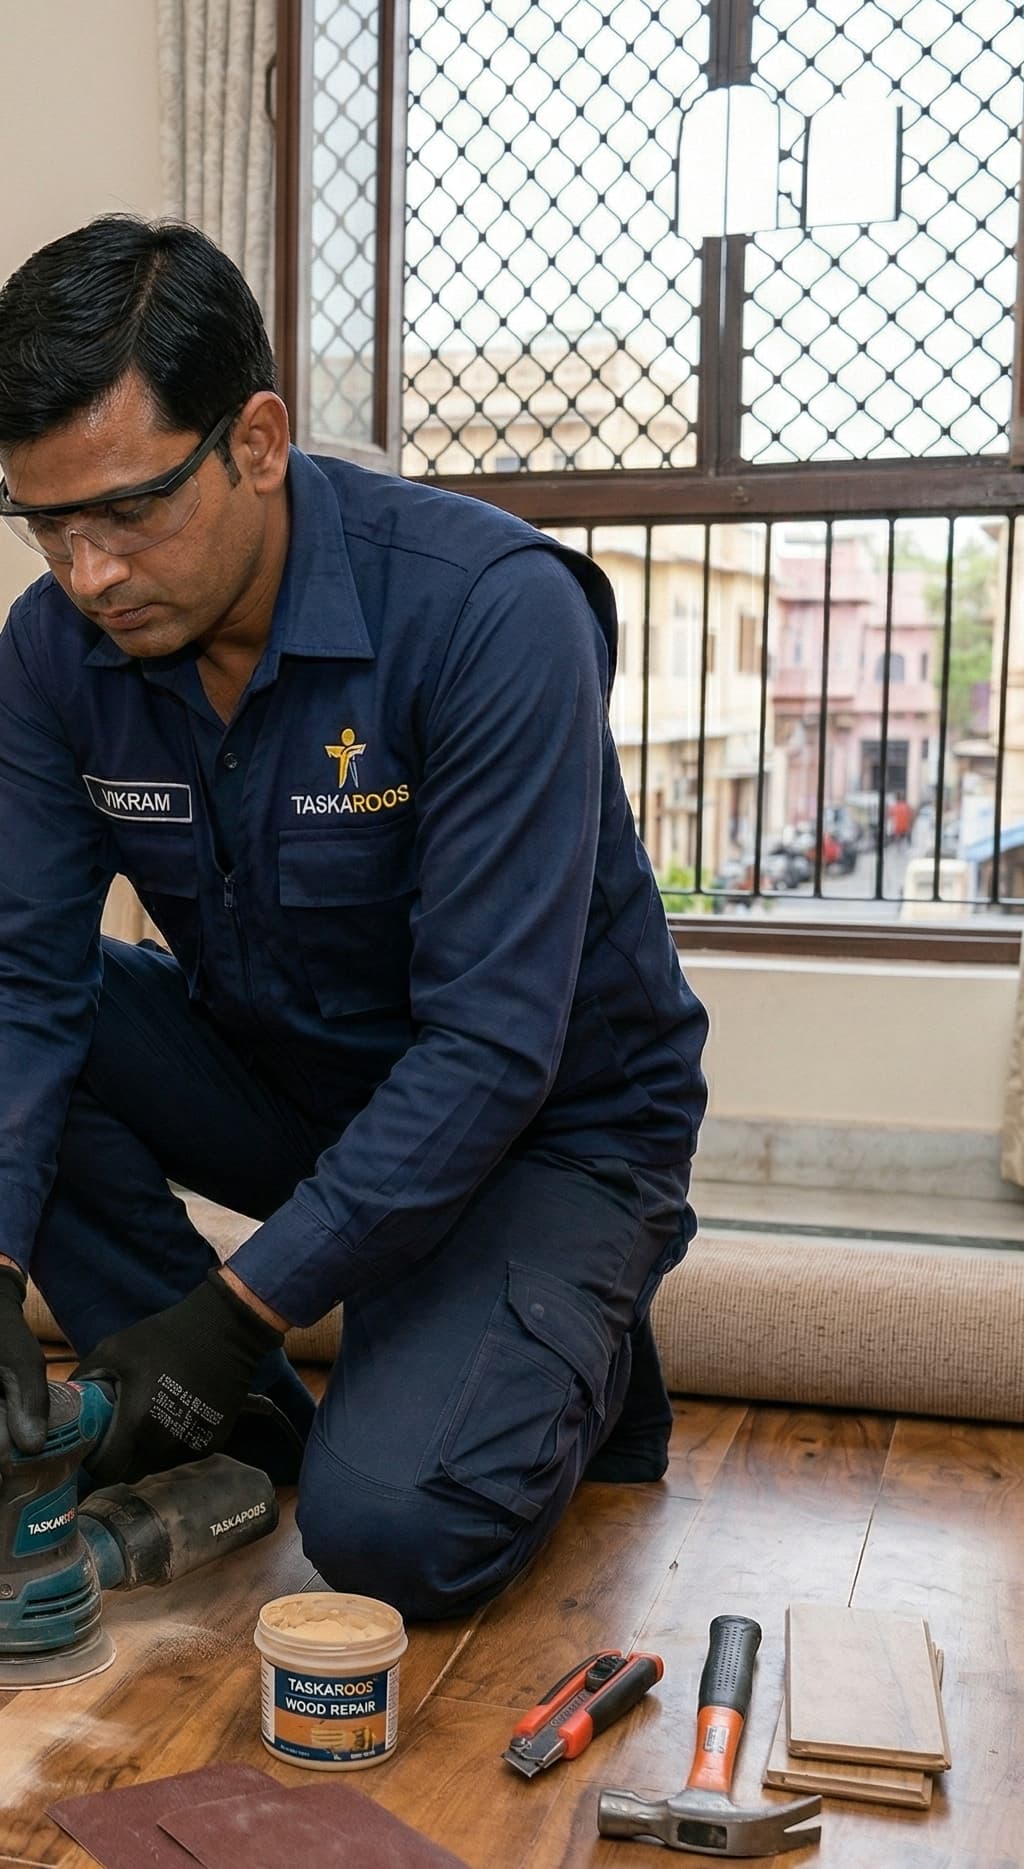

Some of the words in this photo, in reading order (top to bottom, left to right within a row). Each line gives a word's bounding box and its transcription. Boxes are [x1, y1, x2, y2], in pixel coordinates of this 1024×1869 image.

[100, 787, 171, 812] VIKRAM
[290, 784, 410, 815] TASKAROOS
[287, 1677, 374, 1697] TASKAROOS
[285, 1696, 327, 1716] WOOD
[330, 1700, 376, 1716] REPAIR
